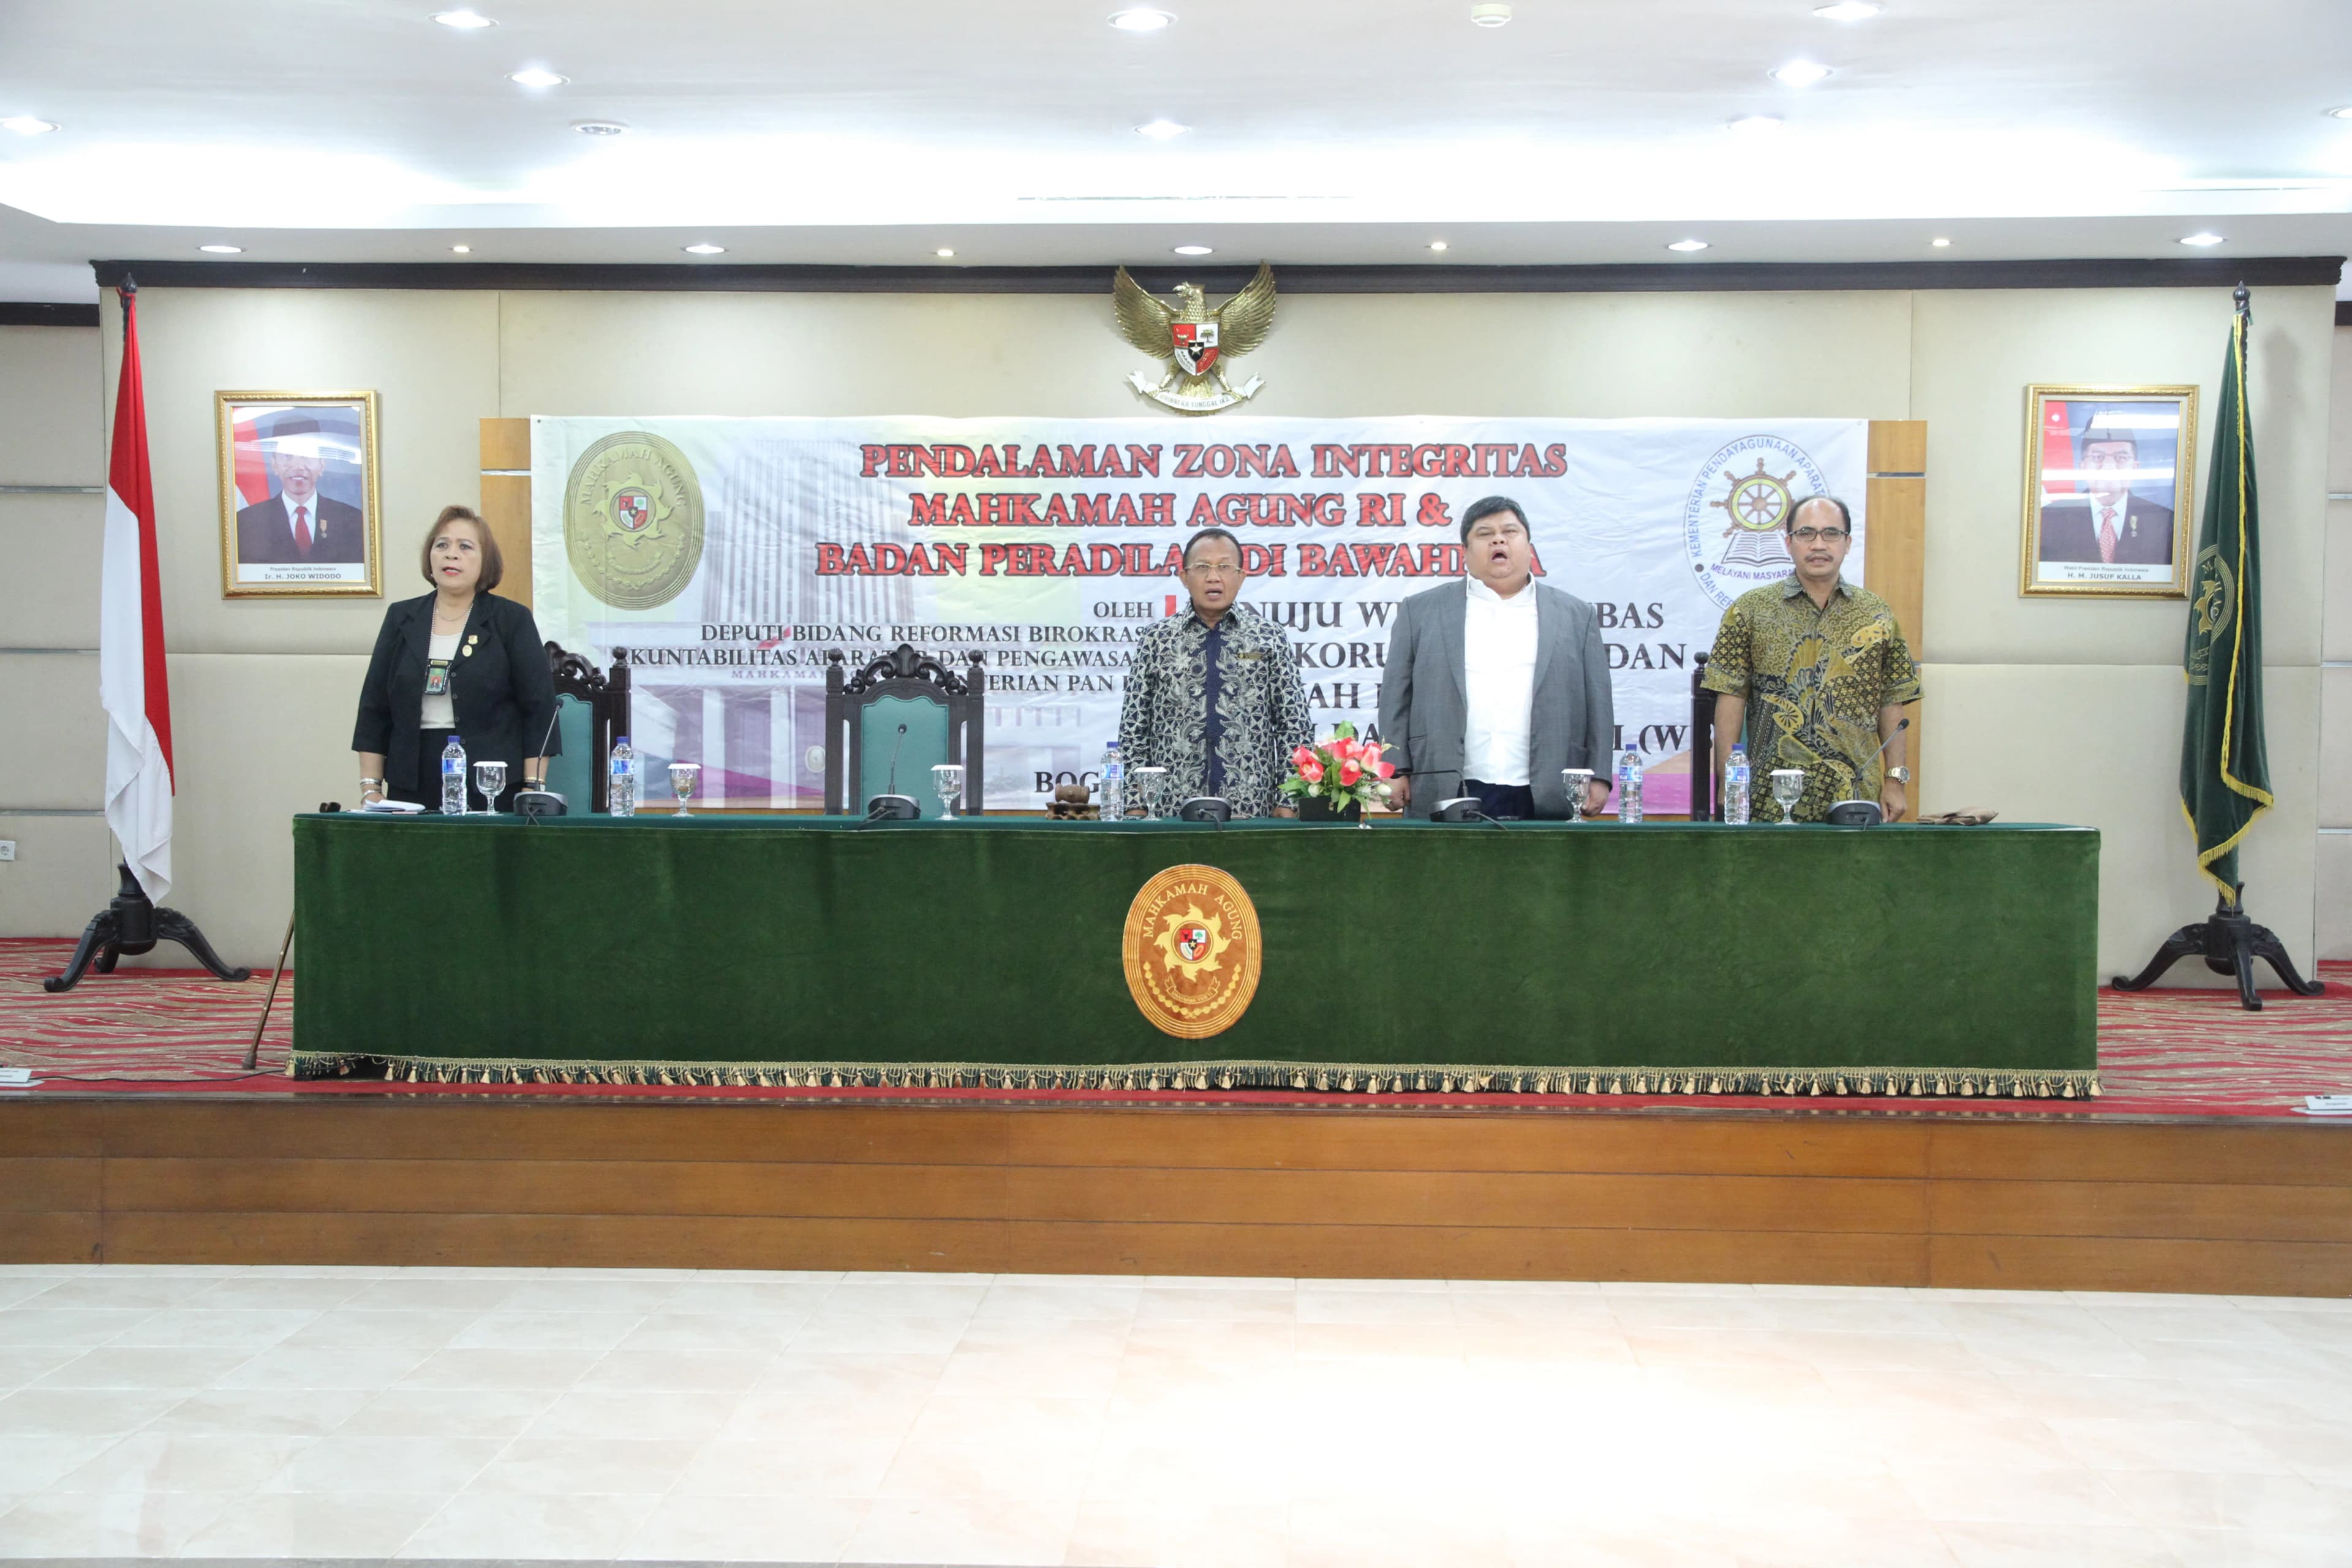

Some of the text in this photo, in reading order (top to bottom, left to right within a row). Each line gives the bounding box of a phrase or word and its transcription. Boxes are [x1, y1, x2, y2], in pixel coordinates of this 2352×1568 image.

[1219, 395, 1230, 404] IKA
[859, 443, 1567, 478] PENDALAMAN ZONA INTEGRITAS
[581, 448, 687, 507] MAHKAMAH AGUNG
[908, 492, 1452, 527] MAHKAMAH AGUNG RI &
[1687, 437, 1826, 558] KEMENTERIAN PENDAYAGUNAAN APARAT
[815, 542, 969, 576] BADAN
[979, 542, 1185, 577] PERADILA
[1239, 543, 1287, 577] DI
[1711, 563, 1796, 580] MELAYANI MASYARA
[1700, 573, 1718, 597] DAN
[1093, 601, 1153, 618] OLEH
[1589, 602, 1664, 628] BAS
[701, 625, 1145, 643] DEPUTI BIDANG REFORMASI BIROKRAS
[626, 649, 797, 666] KUNTABILITAS
[998, 650, 1133, 667] PENGAWASA
[1603, 643, 1687, 669] DAN
[1068, 676, 1112, 691] PAN
[1034, 771, 1101, 793] BOG
[1143, 883, 1243, 941] MAHKAMAH AGUNG
